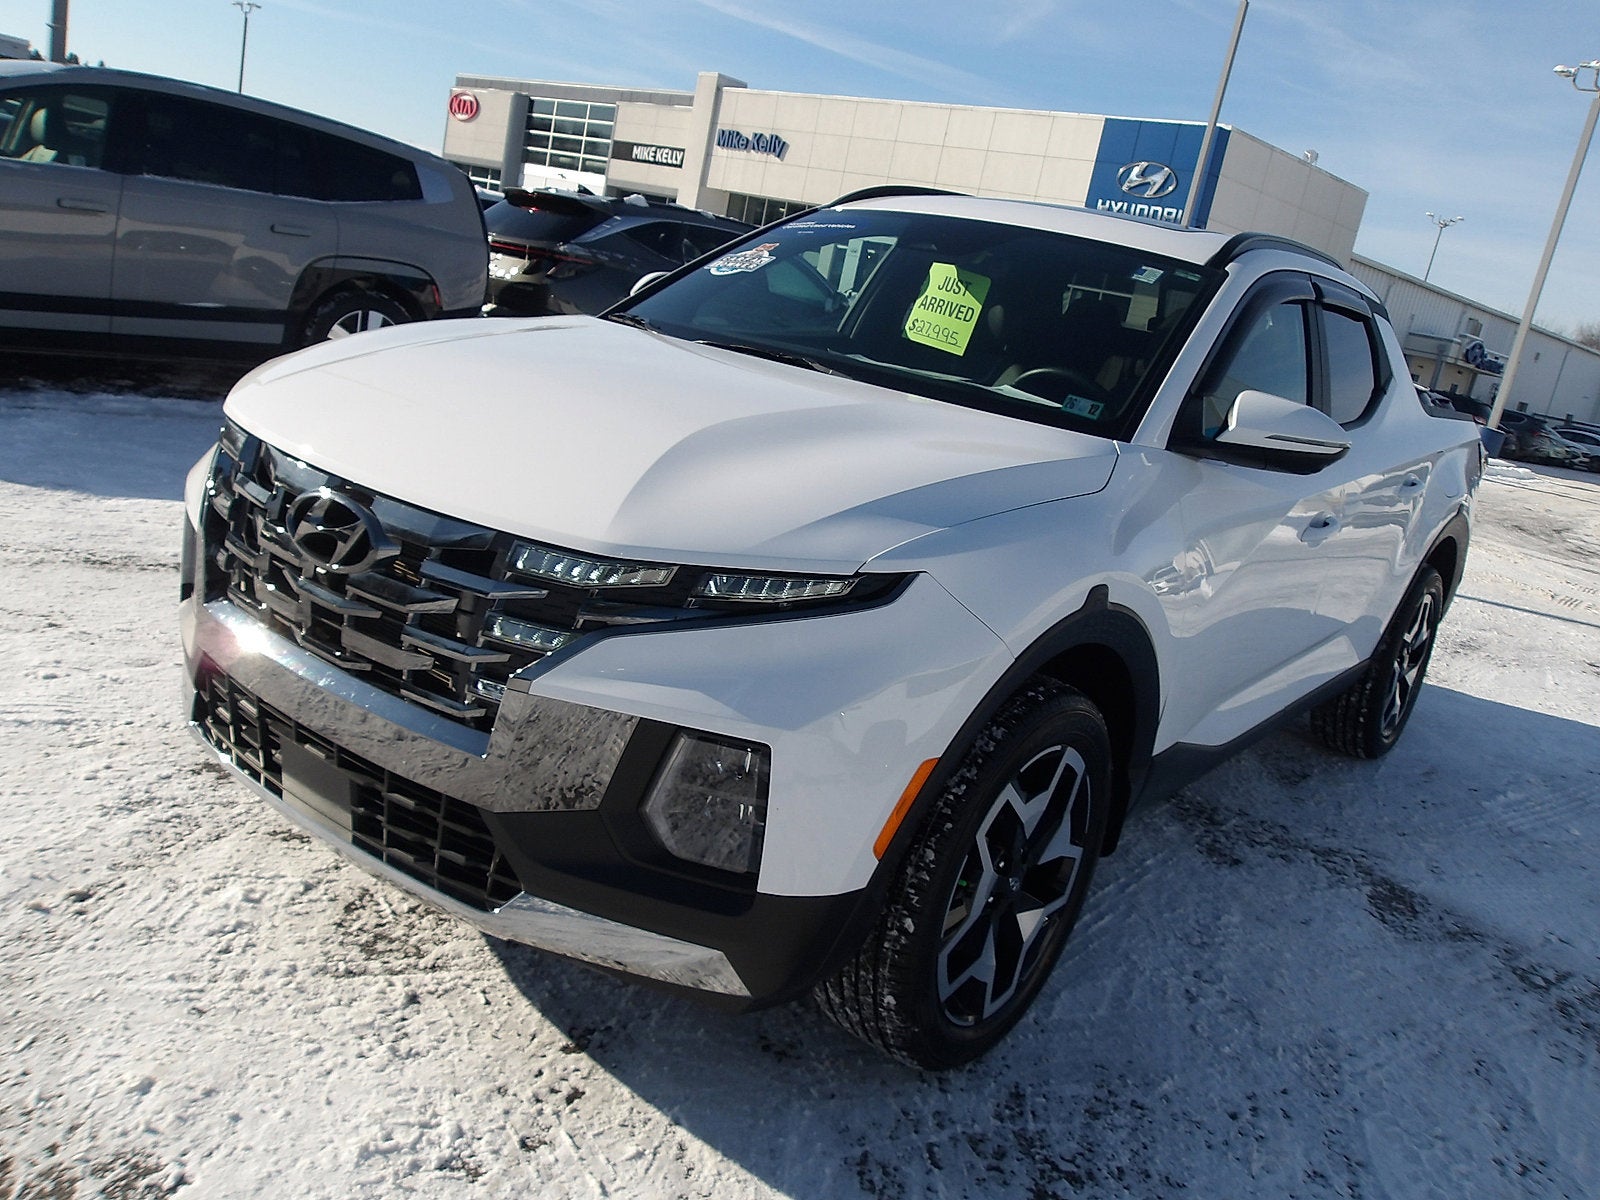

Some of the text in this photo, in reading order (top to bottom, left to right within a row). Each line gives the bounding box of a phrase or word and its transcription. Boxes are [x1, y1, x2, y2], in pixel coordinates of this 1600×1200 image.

[452, 97, 471, 115] KIA
[632, 145, 683, 165] MIKE KELLY
[717, 128, 785, 160] Mike Kelly
[1097, 199, 1184, 224] HYUNDAI
[938, 276, 973, 296] JUST
[918, 295, 975, 322] ARRIVED
